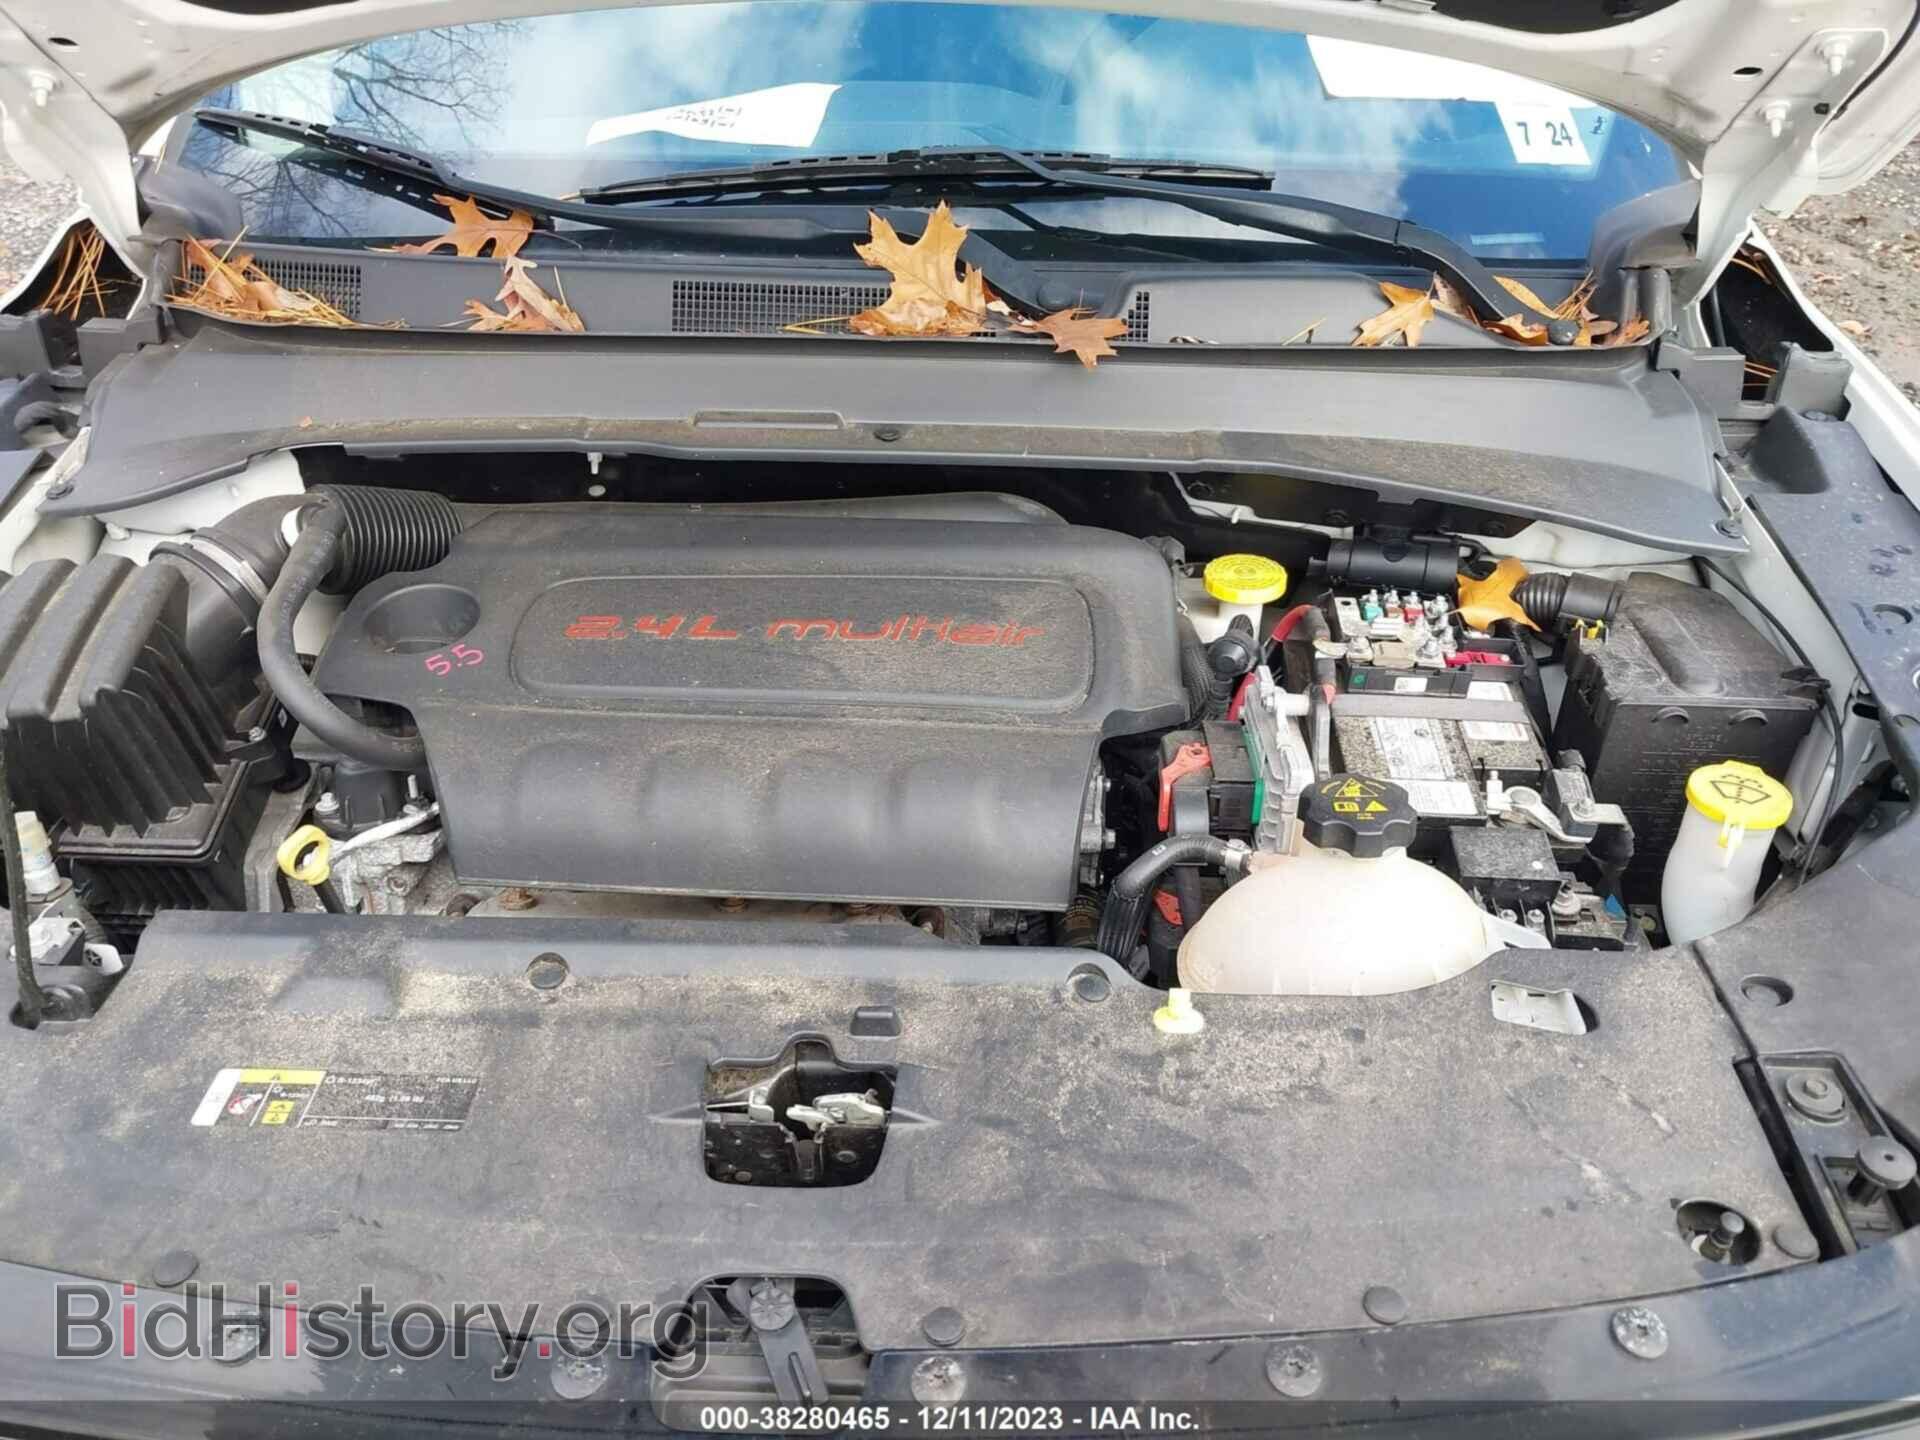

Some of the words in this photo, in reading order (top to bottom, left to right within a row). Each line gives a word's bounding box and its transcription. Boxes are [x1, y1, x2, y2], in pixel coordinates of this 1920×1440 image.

[1515, 121, 1531, 146] 7
[1545, 121, 1573, 146] 24
[563, 613, 743, 640] 2.4L
